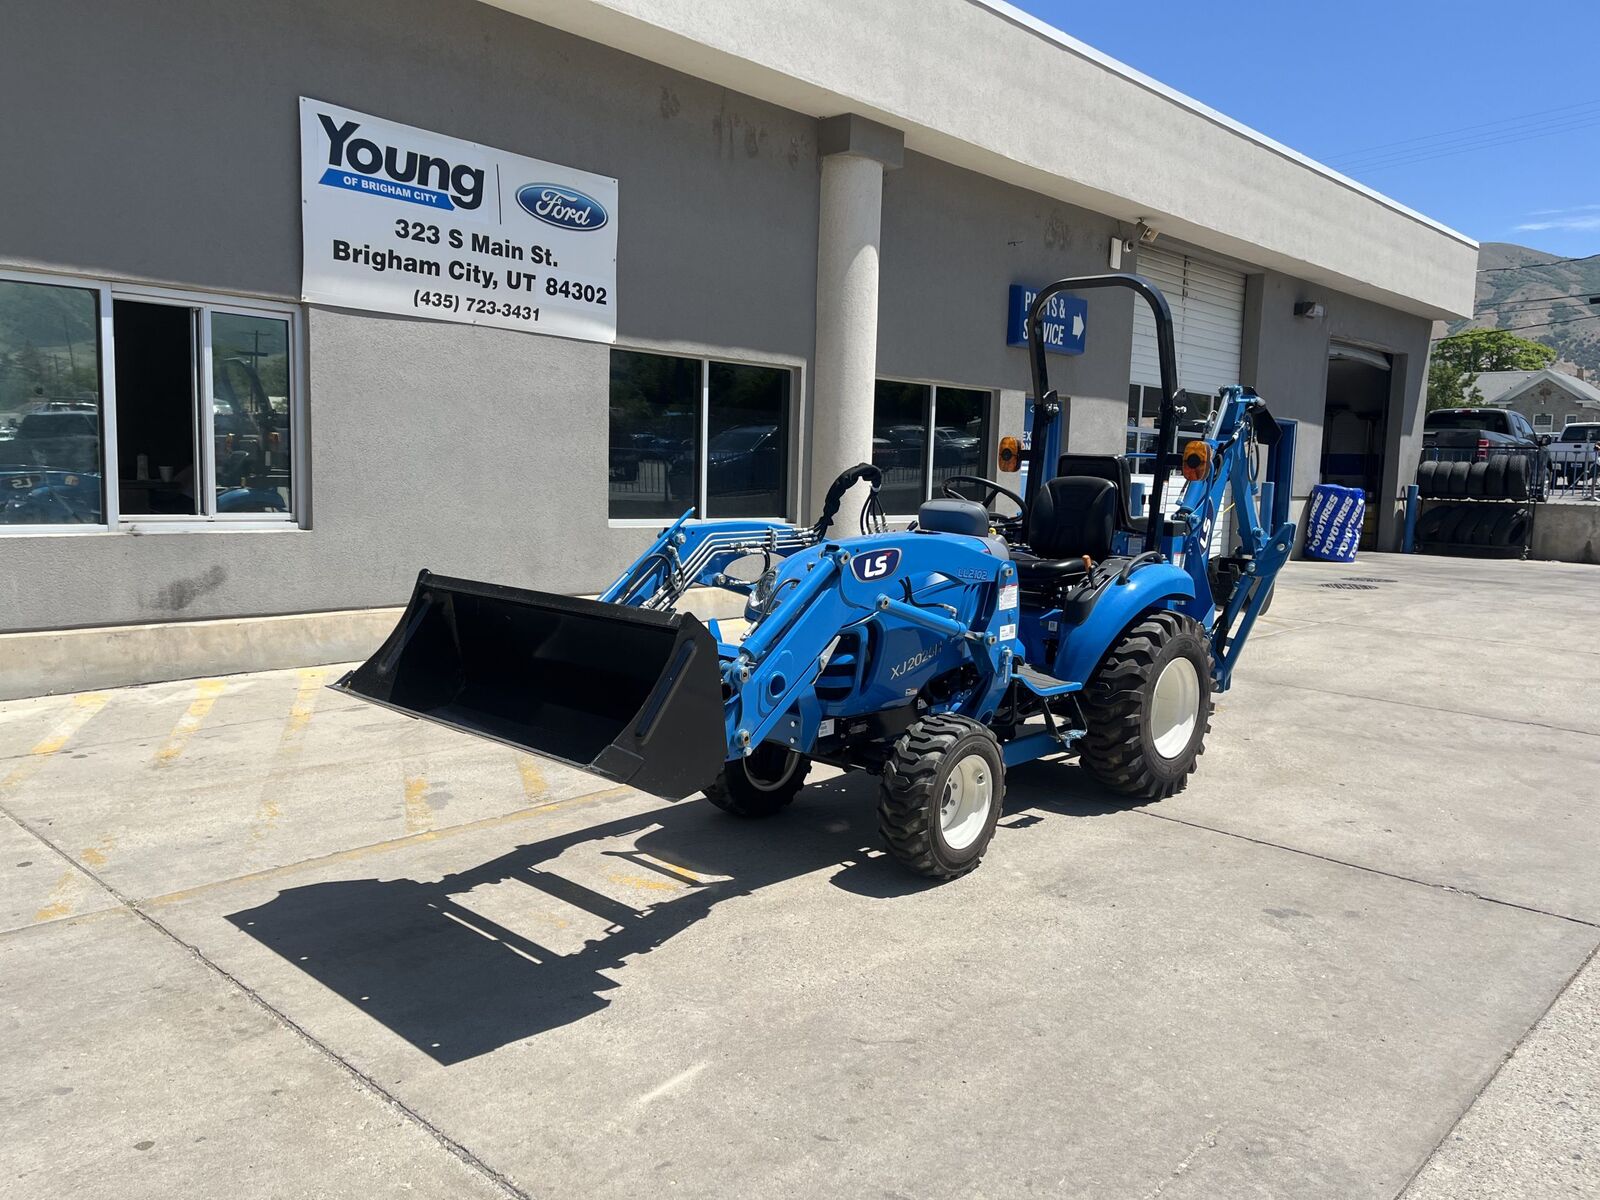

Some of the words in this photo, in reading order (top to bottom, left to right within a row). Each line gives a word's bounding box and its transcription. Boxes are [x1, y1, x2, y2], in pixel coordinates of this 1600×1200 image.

[317, 113, 485, 210] Young
[343, 175, 358, 187] OF
[361, 181, 411, 198] BRIGHAM
[414, 191, 438, 204] CITY
[535, 188, 591, 226] Ford
[395, 218, 441, 245] 323
[448, 229, 464, 249] S
[471, 233, 524, 261] Main
[530, 245, 559, 267] St.
[333, 239, 441, 277] Brigham
[448, 260, 499, 291] City,
[506, 270, 536, 293] UT
[545, 277, 608, 305] 84302
[413, 289, 460, 313] (435)
[466, 297, 541, 322] 723-3431
[1024, 291, 1058, 318] PTS
[1059, 299, 1066, 319] &
[1022, 318, 1065, 346] SVICE
[1200, 517, 1211, 549] LS
[864, 555, 888, 578] LS
[957, 567, 988, 580] LL2102
